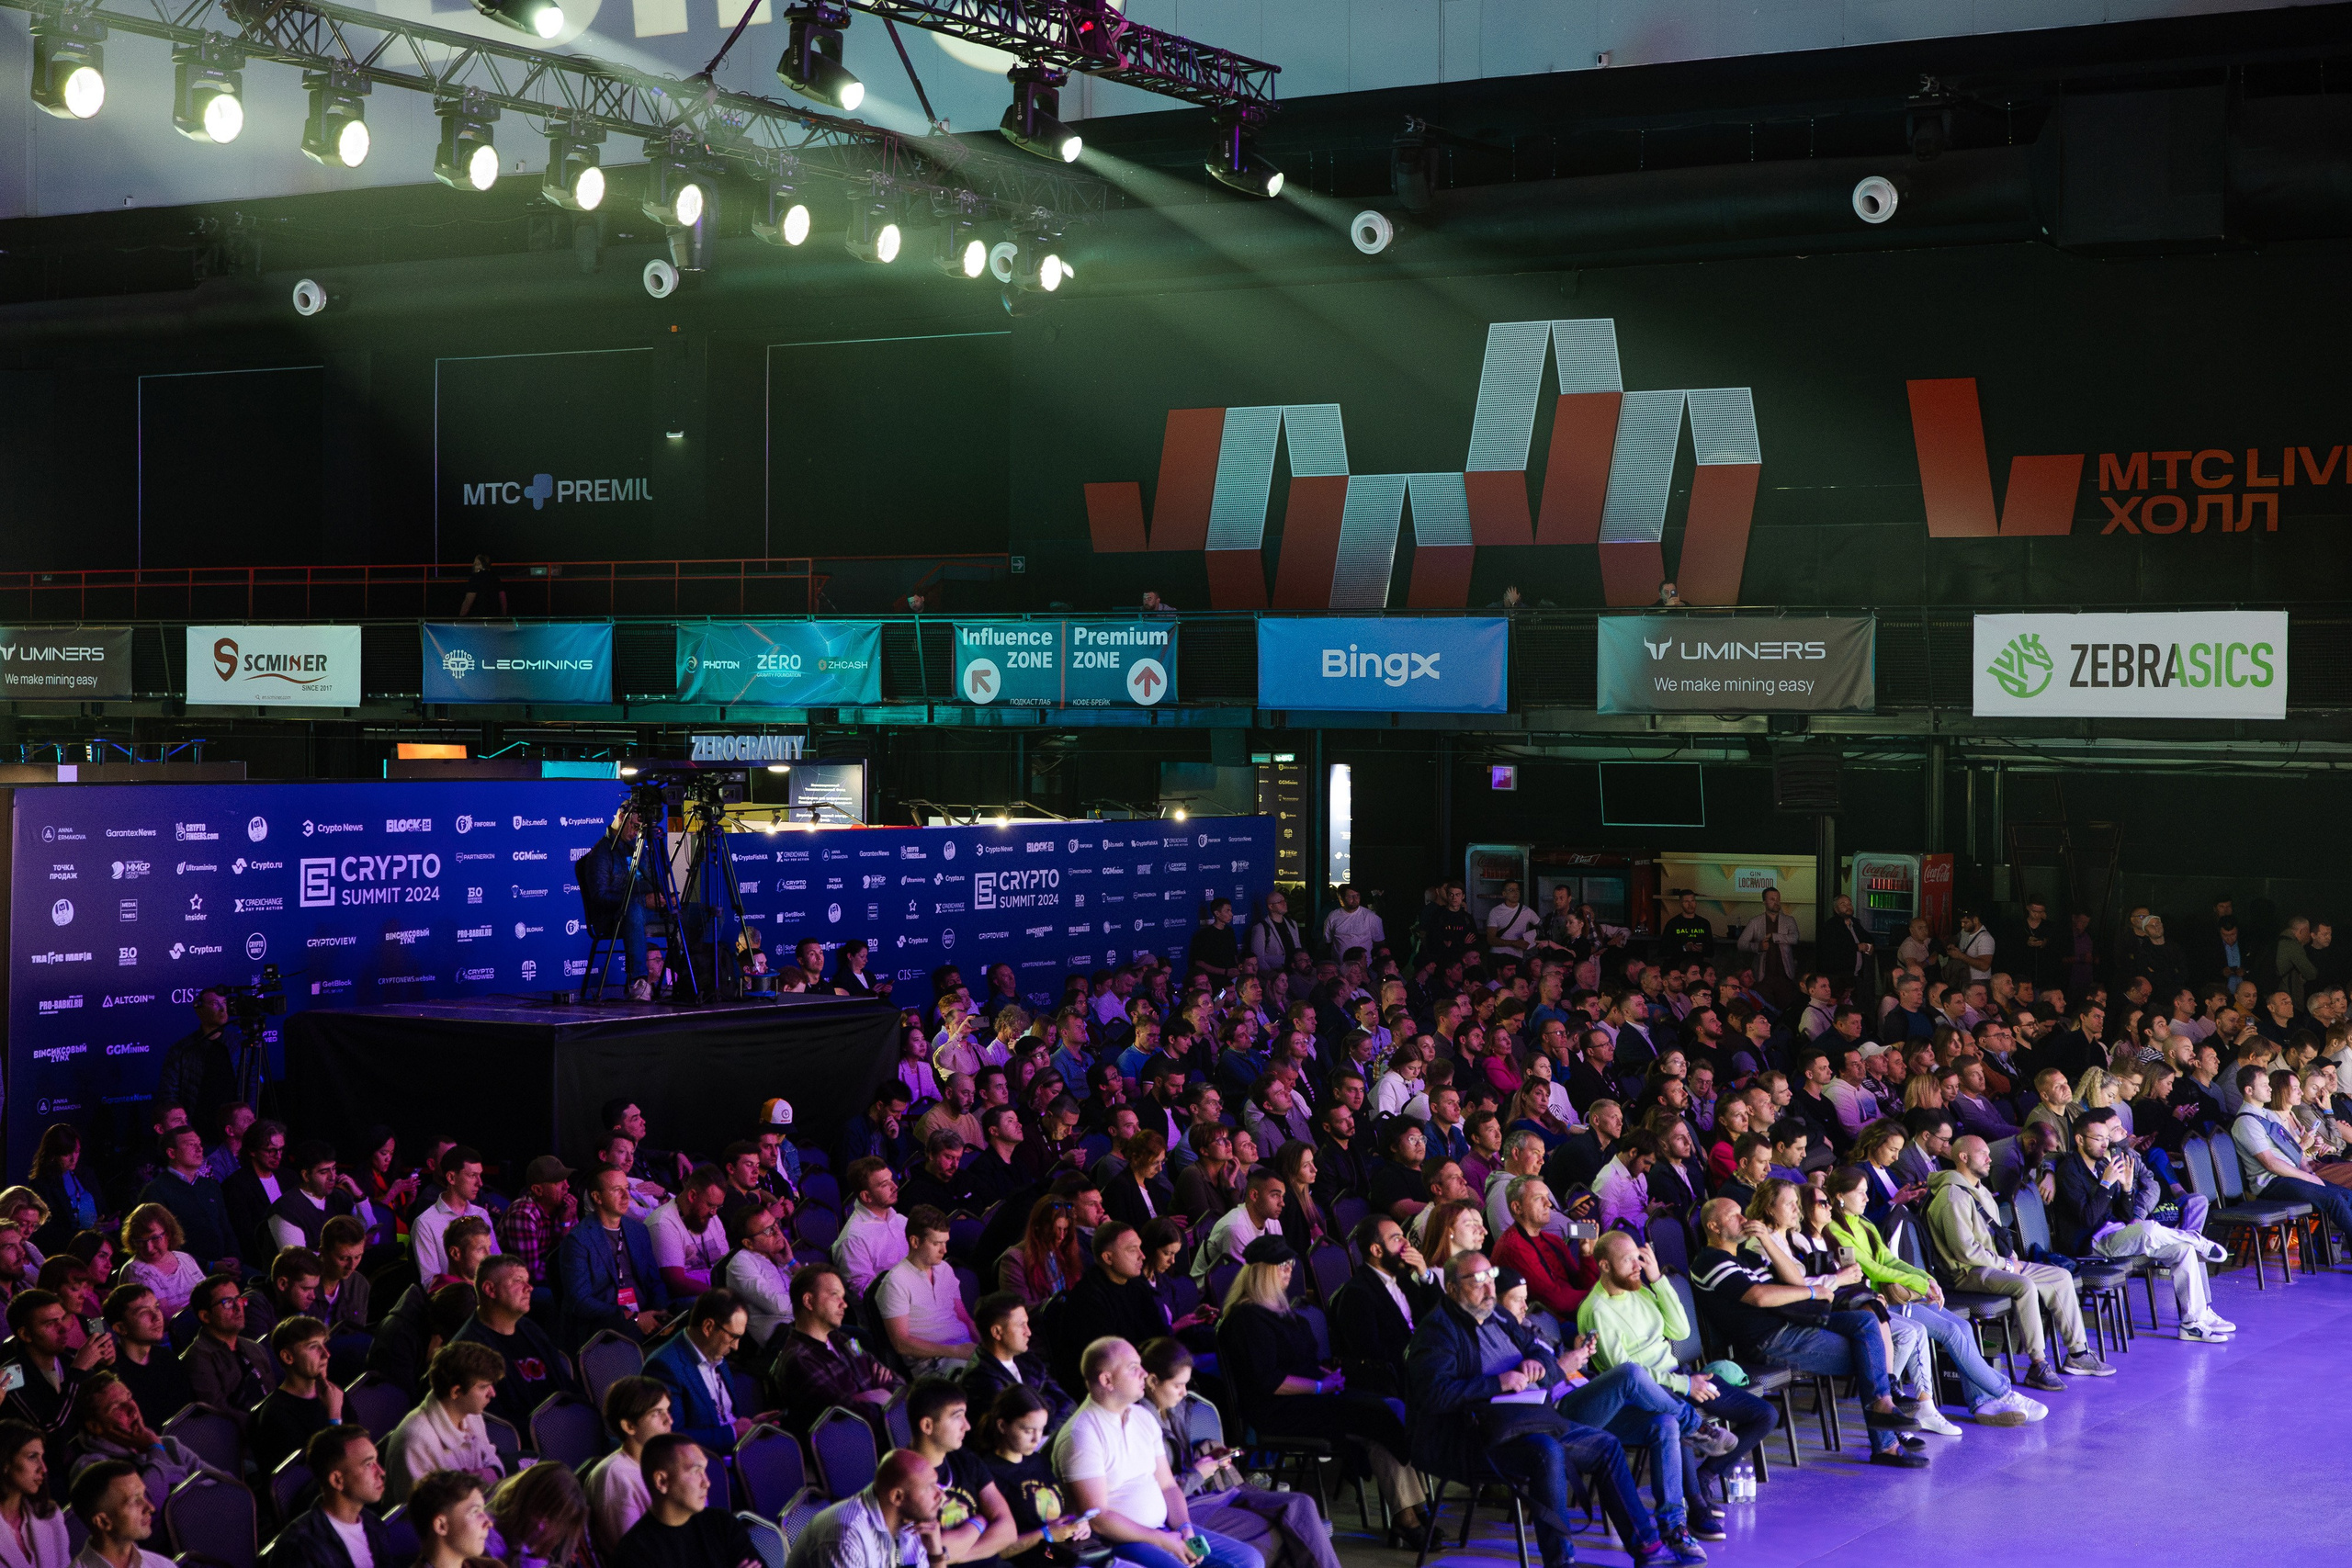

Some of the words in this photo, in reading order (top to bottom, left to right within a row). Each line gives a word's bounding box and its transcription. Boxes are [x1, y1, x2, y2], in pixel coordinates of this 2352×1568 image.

[2246, 445, 2352, 488] LIV
[2100, 493, 2278, 535] ХОЛЛ
[963, 627, 1053, 646] Influence
[1074, 626, 1169, 646] Premium
[20, 647, 105, 661] UMINERS
[1680, 641, 1826, 660] UMINERS
[243, 654, 327, 671] SCMINER
[481, 660, 593, 671] LEOMINING
[703, 660, 740, 670] PHOTON
[757, 654, 801, 670] ZERO
[828, 660, 868, 670] ZHCASH
[1007, 651, 1053, 669] ZONE
[1073, 651, 1120, 669] ZONE
[2069, 641, 2275, 690] ZEBRASICS
[5, 672, 19, 684] We
[20, 672, 44, 684] make
[45, 673, 75, 688] mining
[76, 675, 98, 688] easy
[1654, 676, 1678, 693] We
[1679, 675, 1722, 693] make
[1724, 676, 1775, 697] mining
[1779, 680, 1815, 697] easy
[1010, 698, 1038, 706] ПОДКАСТ
[1073, 697, 1111, 706] КОФЕ-БРЕЙК
[691, 735, 806, 761] ZEROGRAVITY
[186, 823, 206, 832] CRYPTO
[318, 824, 342, 834] Crypto
[343, 823, 363, 831] News
[522, 818, 548, 827] bits.media
[106, 829, 156, 838] GarantexNews
[985, 846, 1001, 854] Crypto
[1574, 854, 1595, 863] Bud
[126, 863, 151, 872] MMGP
[186, 863, 217, 872] Ultramining
[251, 861, 283, 870] Crypto.ru
[341, 853, 441, 882] CRYPTO
[999, 868, 1060, 891] CRYPTO
[342, 887, 401, 905] SUMMIT
[405, 886, 440, 902] 2024
[1000, 894, 1036, 908] SUMMIT
[1037, 893, 1059, 906] 2024
[185, 913, 208, 921] Insider
[307, 937, 356, 947] CRYPTOVIEW
[908, 937, 928, 945] Crypto.ru
[188, 945, 222, 954] Crypto.ru
[898, 969, 911, 981] CIS
[322, 979, 352, 987] GetBlock
[114, 996, 148, 1004] ALTCOIN
[172, 988, 194, 1003] CIS
